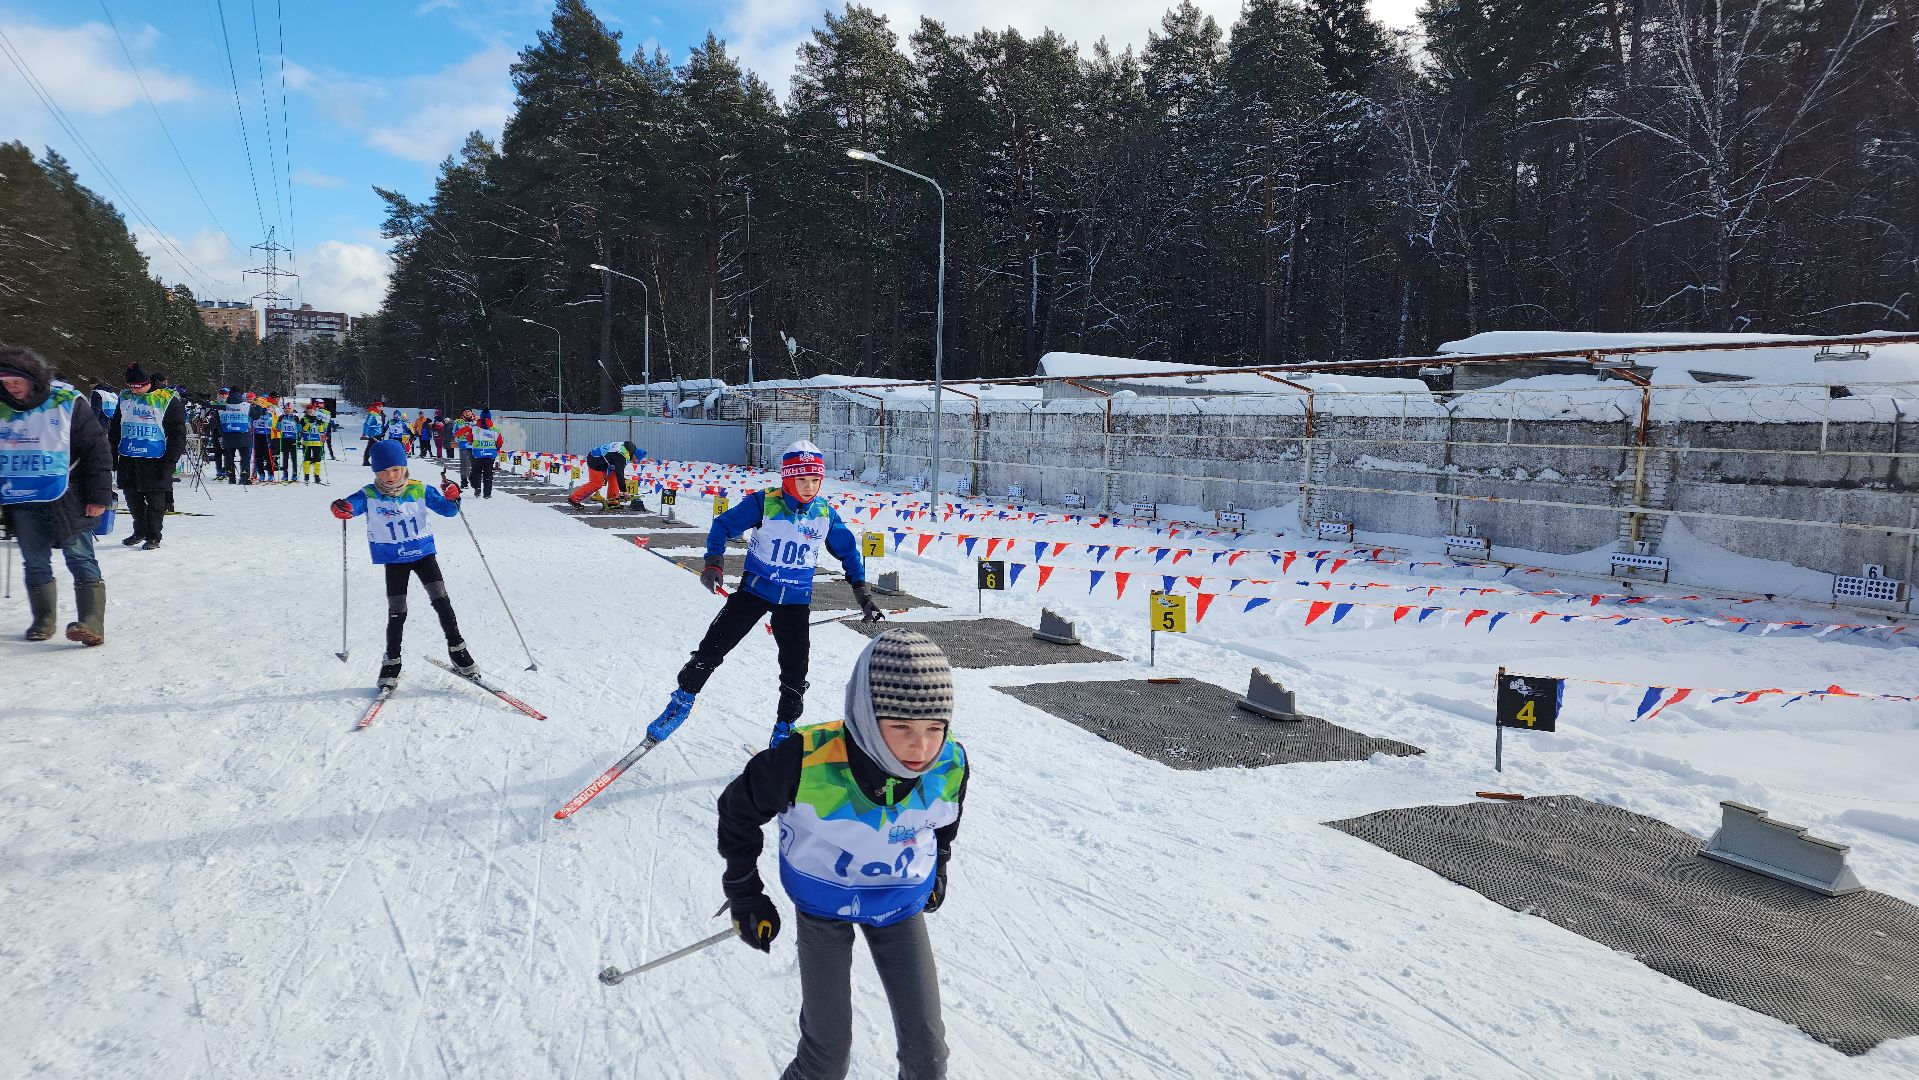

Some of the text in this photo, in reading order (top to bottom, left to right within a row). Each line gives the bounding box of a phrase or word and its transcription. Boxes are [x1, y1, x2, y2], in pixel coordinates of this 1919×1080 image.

[627, 485, 635, 494] 11
[663, 495, 674, 505] 10
[717, 505, 723, 515] 9
[385, 516, 419, 541] 111
[770, 538, 811, 566] 109
[869, 543, 877, 556] 7
[1638, 542, 1646, 553] 7
[1868, 566, 1878, 579] 6
[986, 573, 996, 589] 6
[1162, 611, 1175, 630] 5
[1515, 700, 1537, 727] 4
